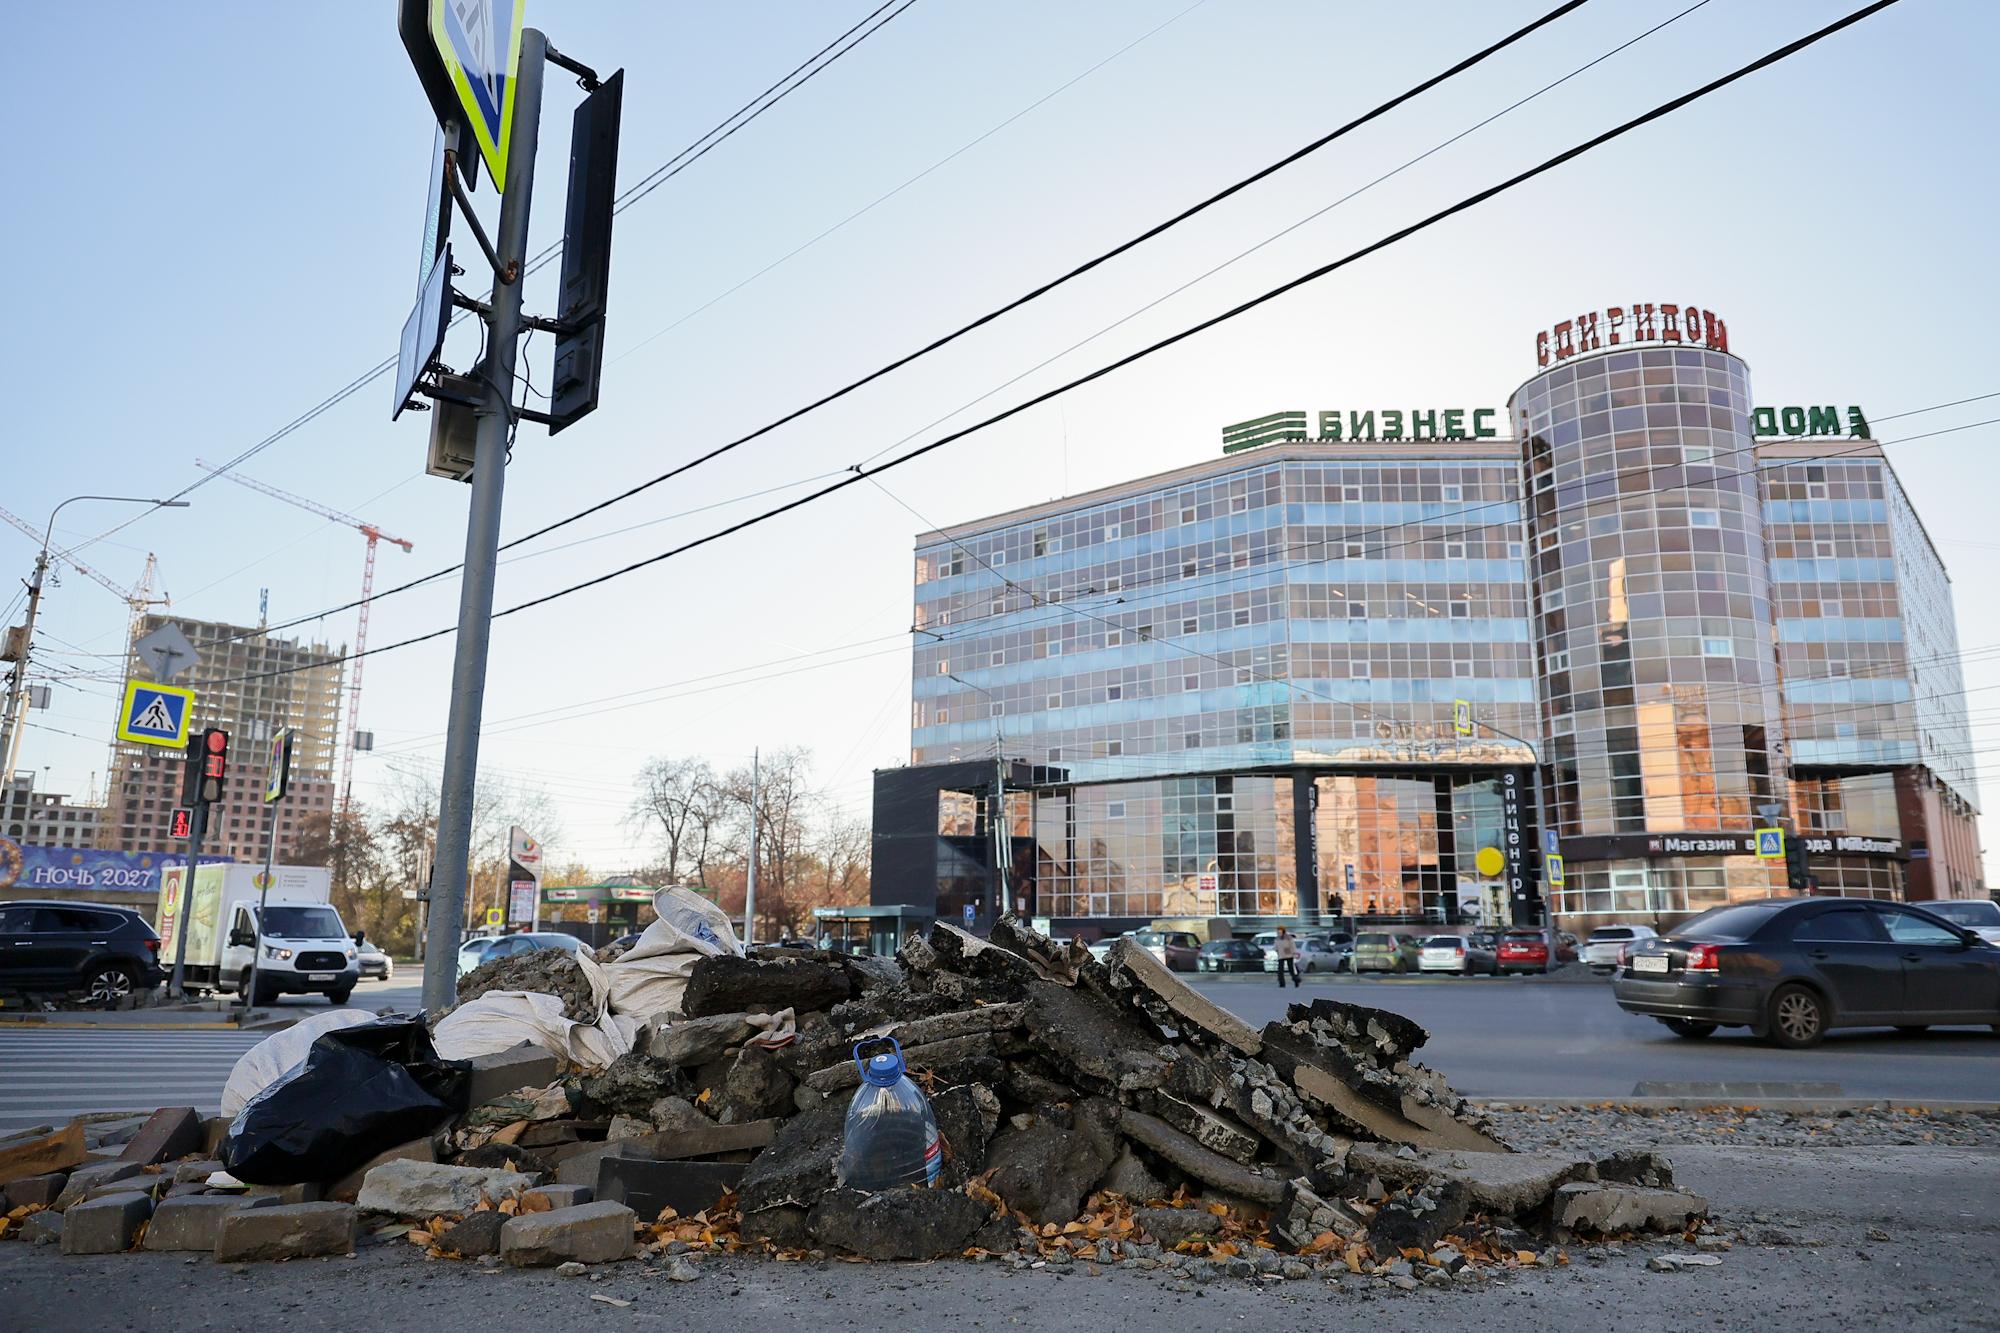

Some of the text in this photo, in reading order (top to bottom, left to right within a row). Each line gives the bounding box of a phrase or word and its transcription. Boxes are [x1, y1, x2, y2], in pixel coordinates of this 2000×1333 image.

[1319, 406, 1841, 438] БИЗНЕС ДОМ
[206, 755, 225, 777] 30
[1665, 838, 1737, 852] Магазин
[35, 867, 153, 887] НОЧЬ 2027
